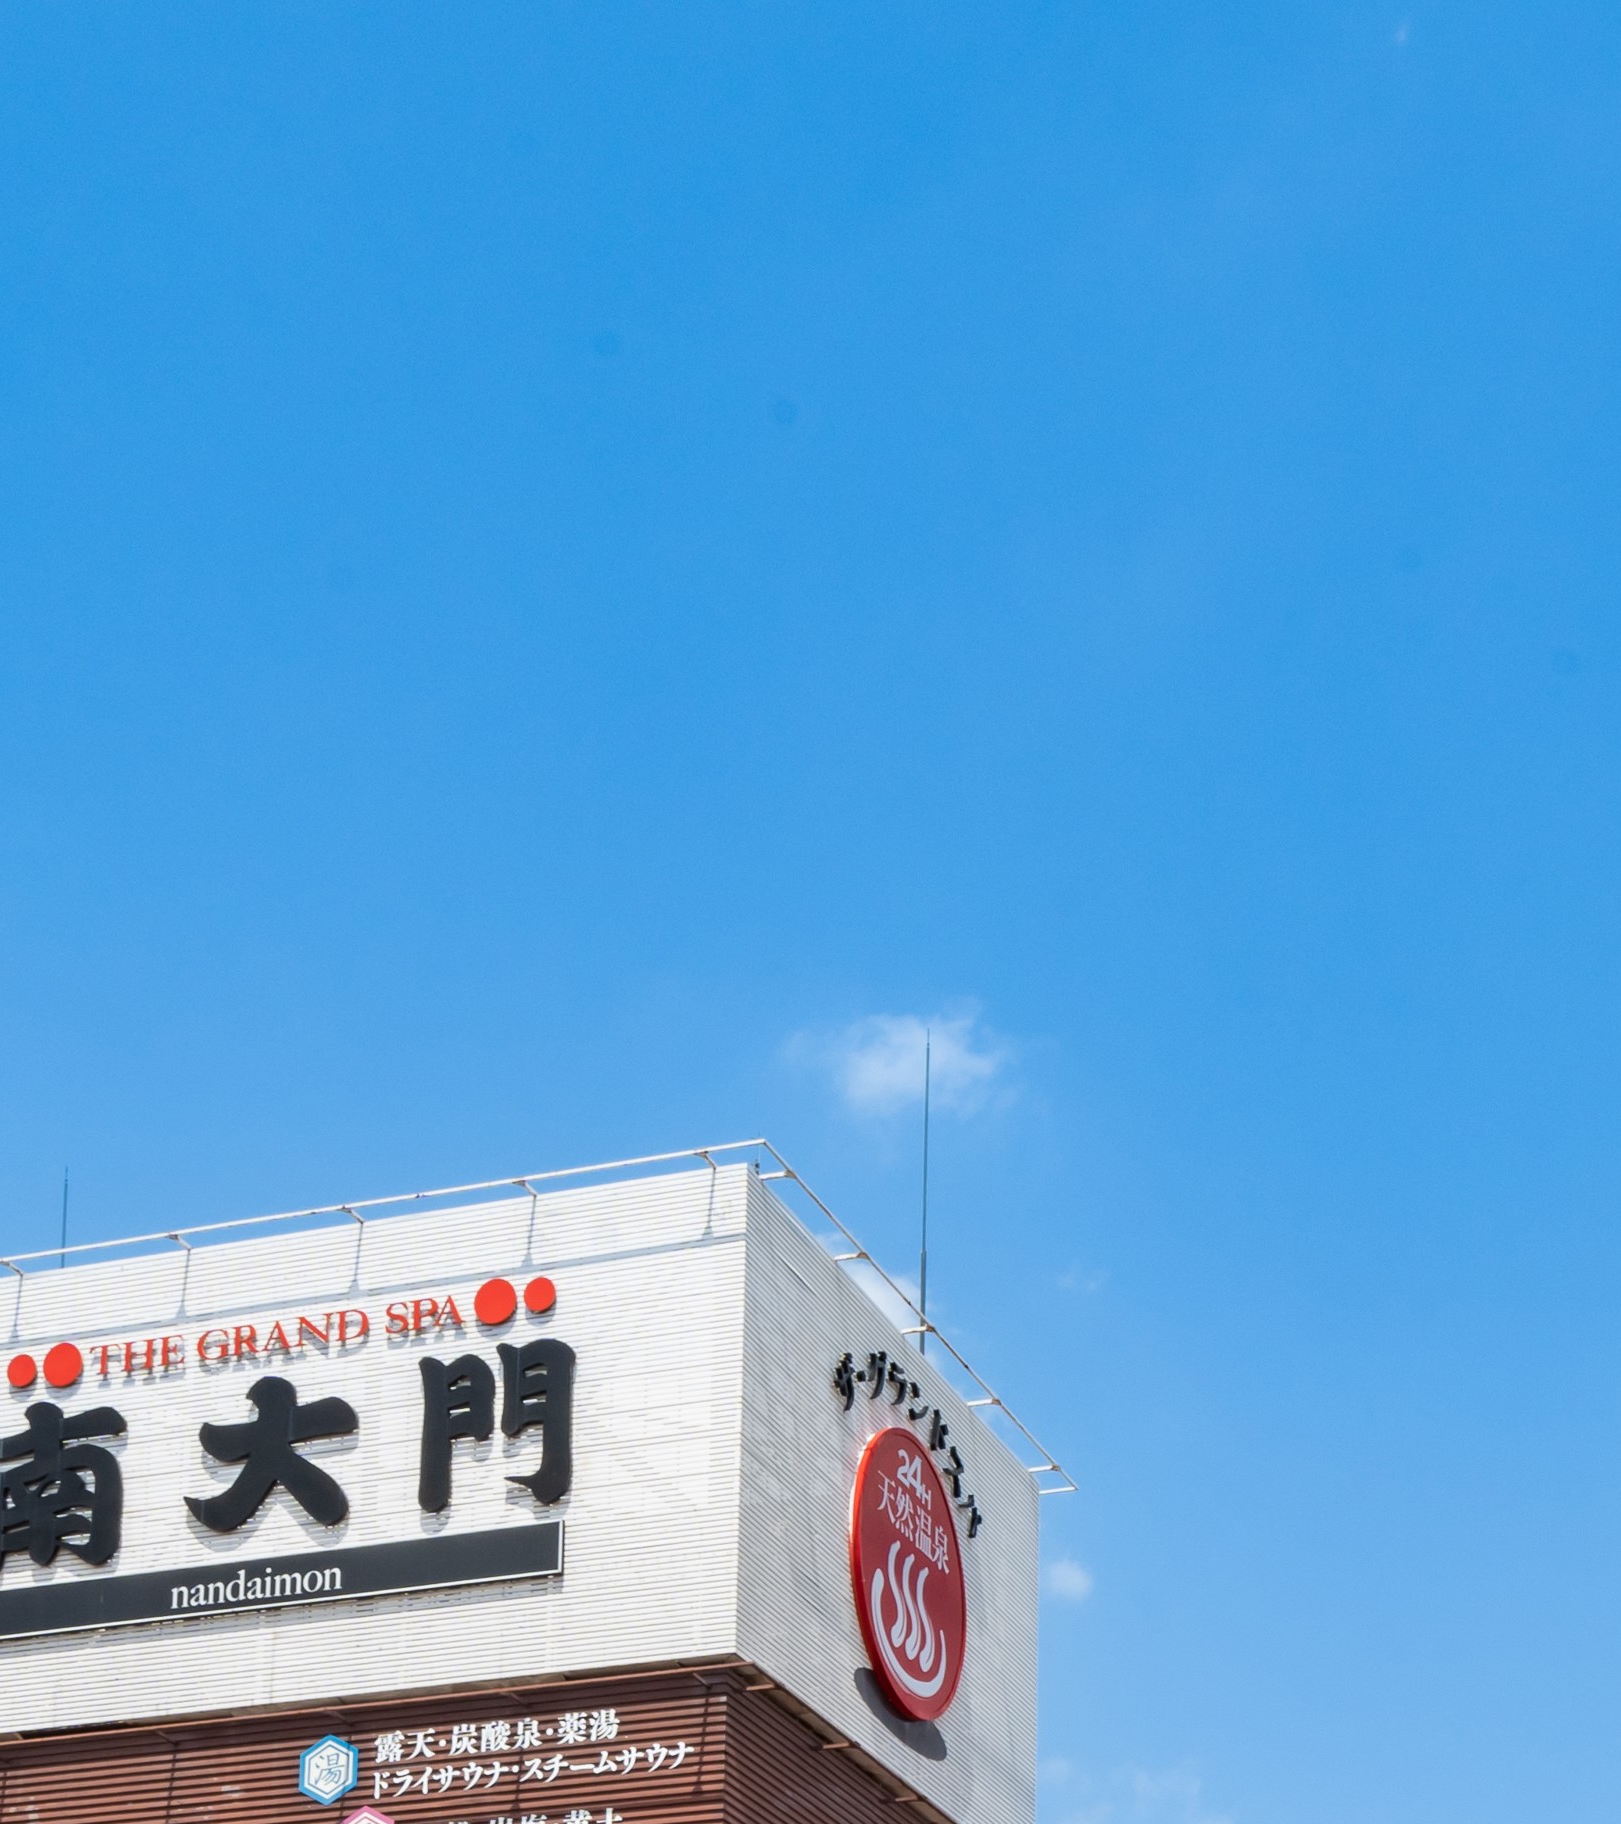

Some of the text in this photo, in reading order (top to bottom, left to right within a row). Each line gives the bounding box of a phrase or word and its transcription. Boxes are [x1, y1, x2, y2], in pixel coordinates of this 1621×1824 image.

[90, 1295, 466, 1376] THE GRAND SPA
[897, 1449, 931, 1510] 24H
[878, 1471, 949, 1574] 天然温泉
[170, 1563, 343, 1610] nandaimon
[373, 1708, 620, 1764] 露天・炭酸泉・薬湯
[315, 1752, 345, 1786] 湯
[372, 1741, 695, 1800] ドライサウナ・スチームサウナ
